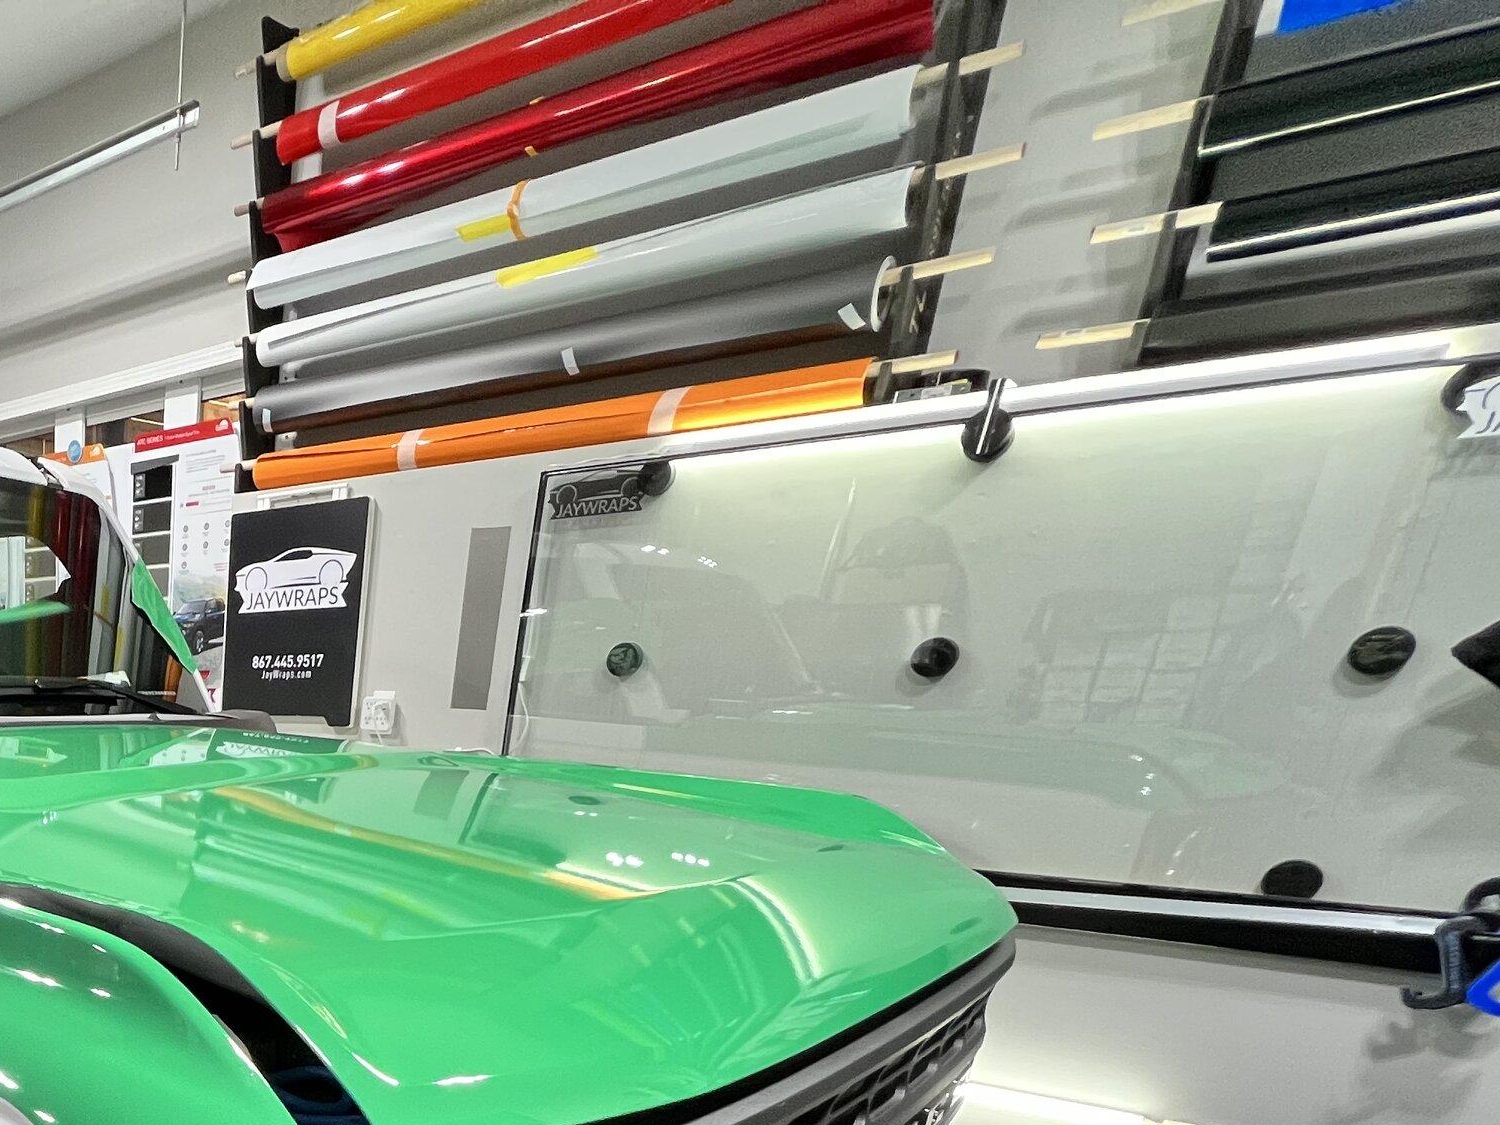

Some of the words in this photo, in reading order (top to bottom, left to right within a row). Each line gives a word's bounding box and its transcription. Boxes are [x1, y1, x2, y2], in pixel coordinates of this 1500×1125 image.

[556, 495, 638, 518] JAYWRAPS
[246, 586, 339, 610] JAYWRAPS
[251, 653, 324, 669] 867.445.9517
